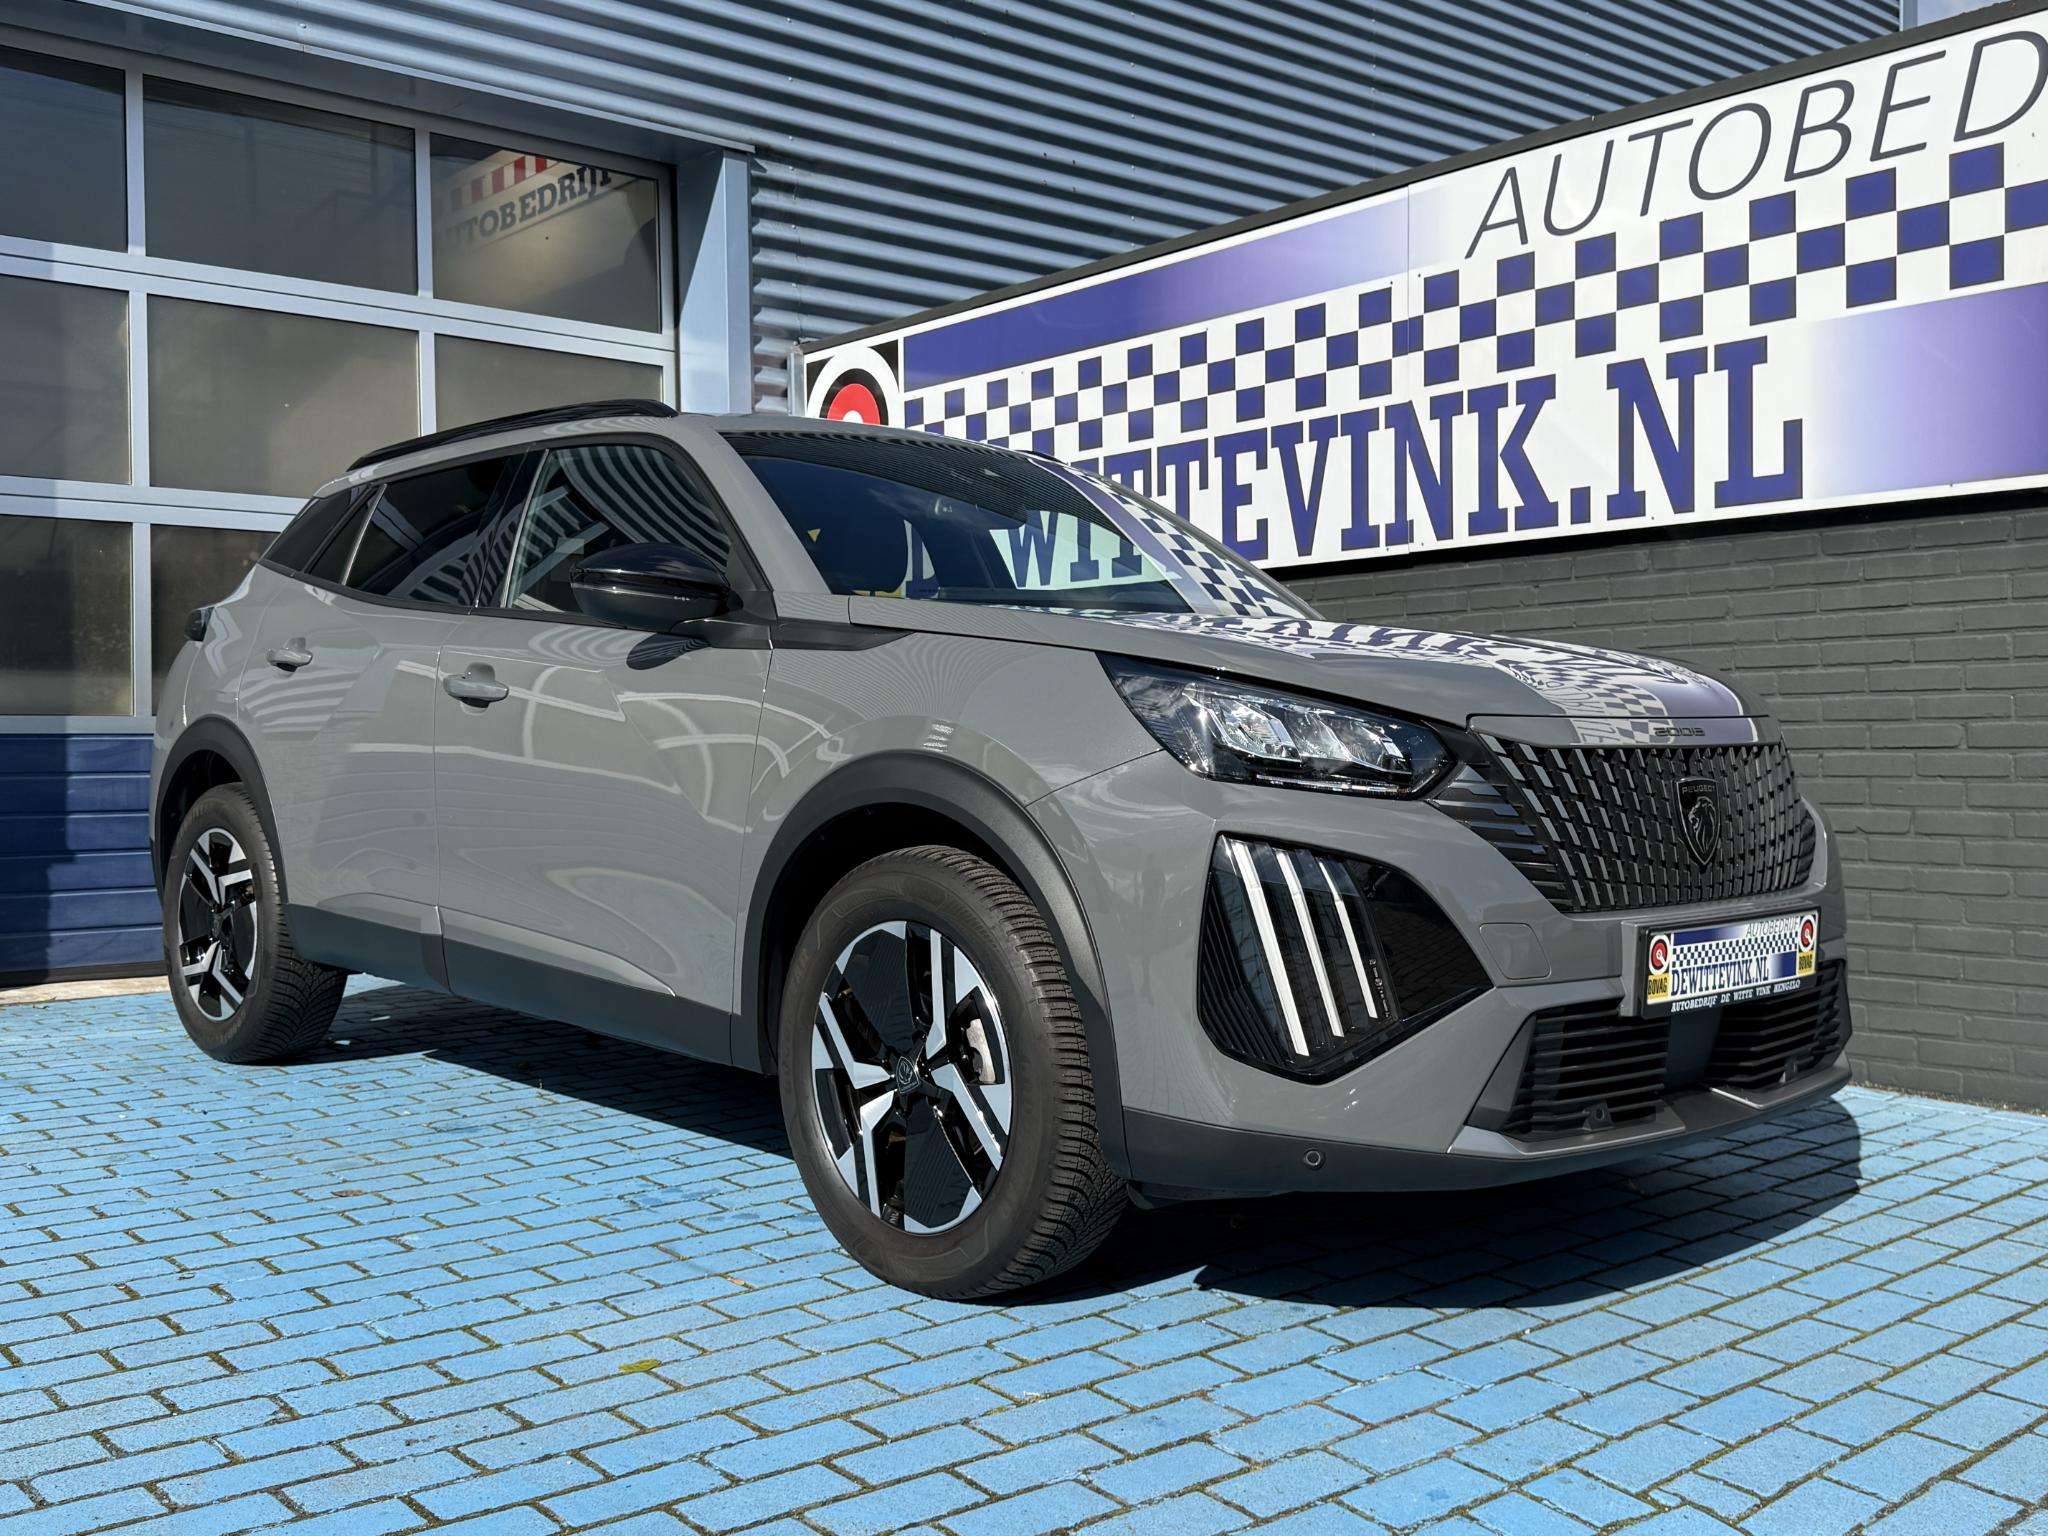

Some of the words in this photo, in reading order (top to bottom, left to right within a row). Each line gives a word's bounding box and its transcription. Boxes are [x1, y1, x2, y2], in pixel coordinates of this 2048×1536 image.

[1465, 30, 2048, 259] AUTOBED
[1647, 977, 1668, 995] BOVAG
[1671, 956, 1769, 997] DEWITTEVINK.NL
[1671, 995, 1718, 1012] AUTOBEDRIJF
[1720, 993, 1731, 1003] DE
[1733, 988, 1754, 1001] WITTE
[1756, 985, 1771, 996] VINK
[1773, 979, 1801, 993] HENGELO
